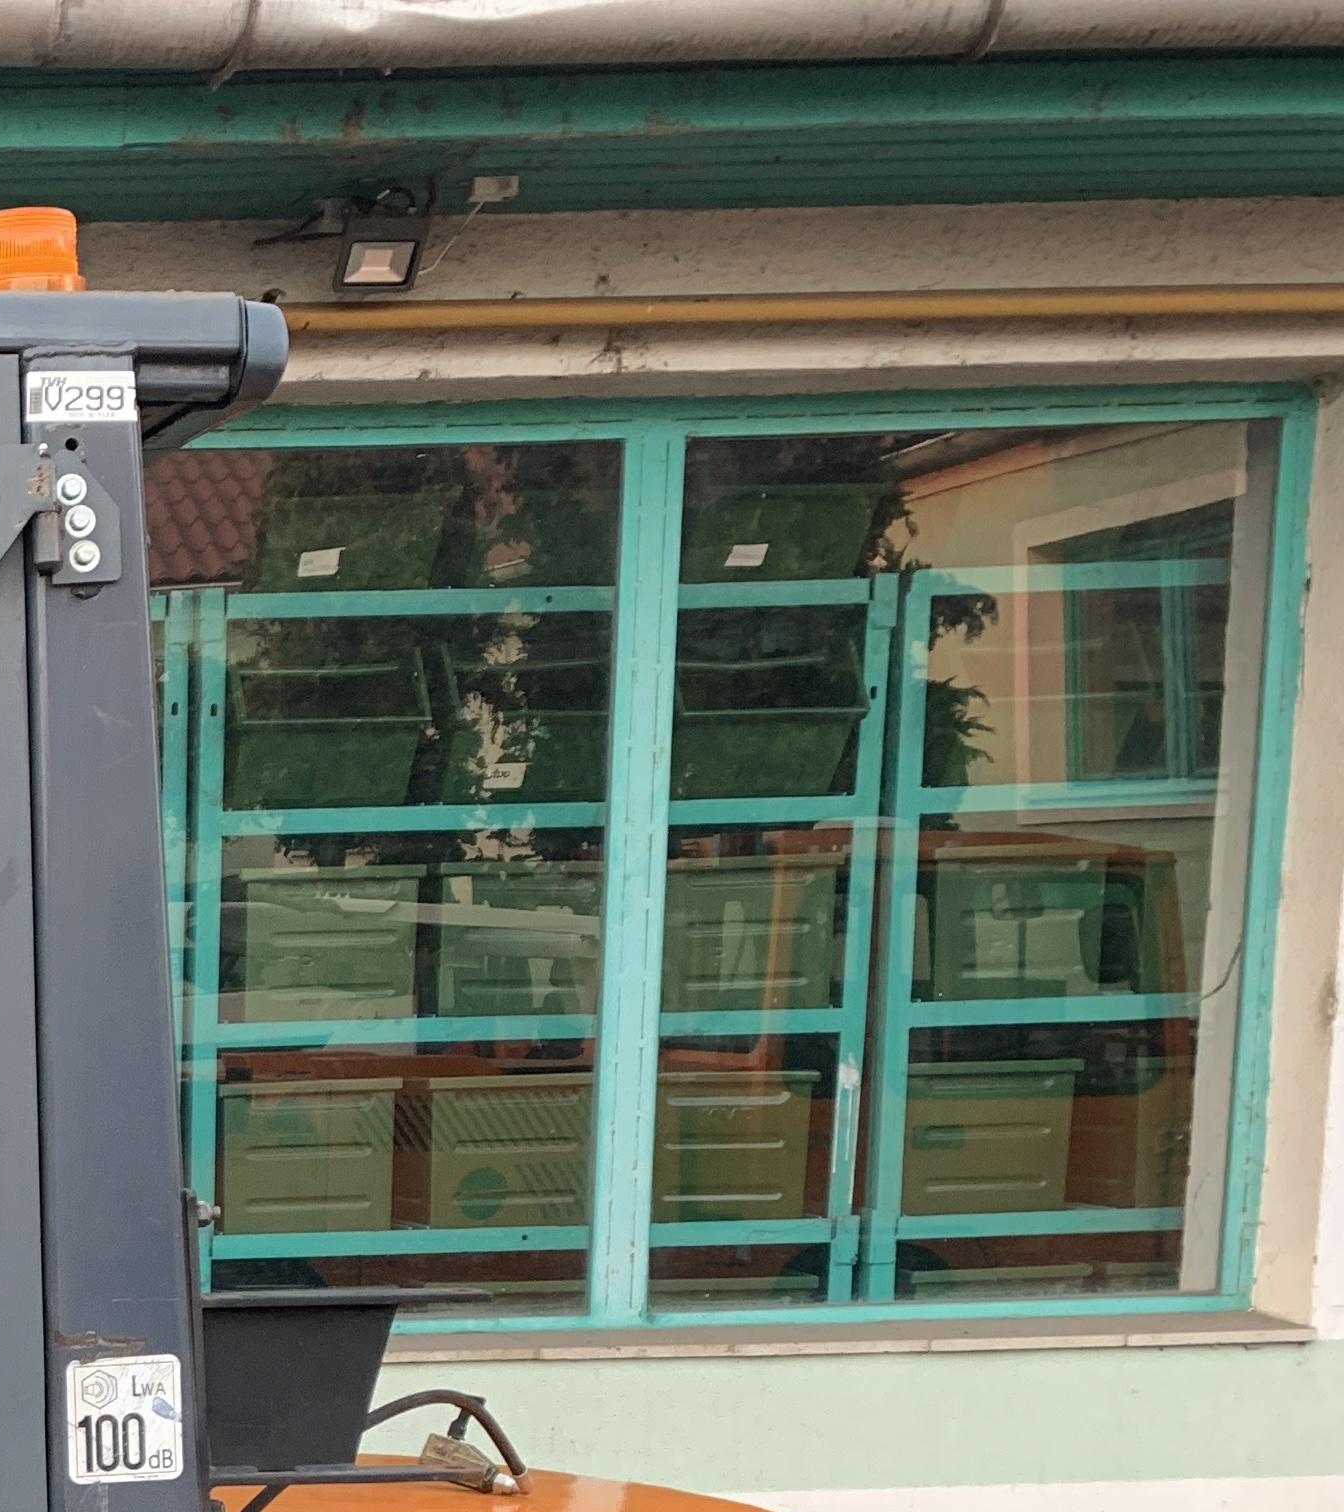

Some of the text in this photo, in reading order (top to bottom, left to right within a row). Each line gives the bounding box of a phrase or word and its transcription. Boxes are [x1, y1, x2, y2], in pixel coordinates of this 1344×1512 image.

[40, 376, 67, 387] TVH
[78, 1413, 173, 1473] 100 dB
